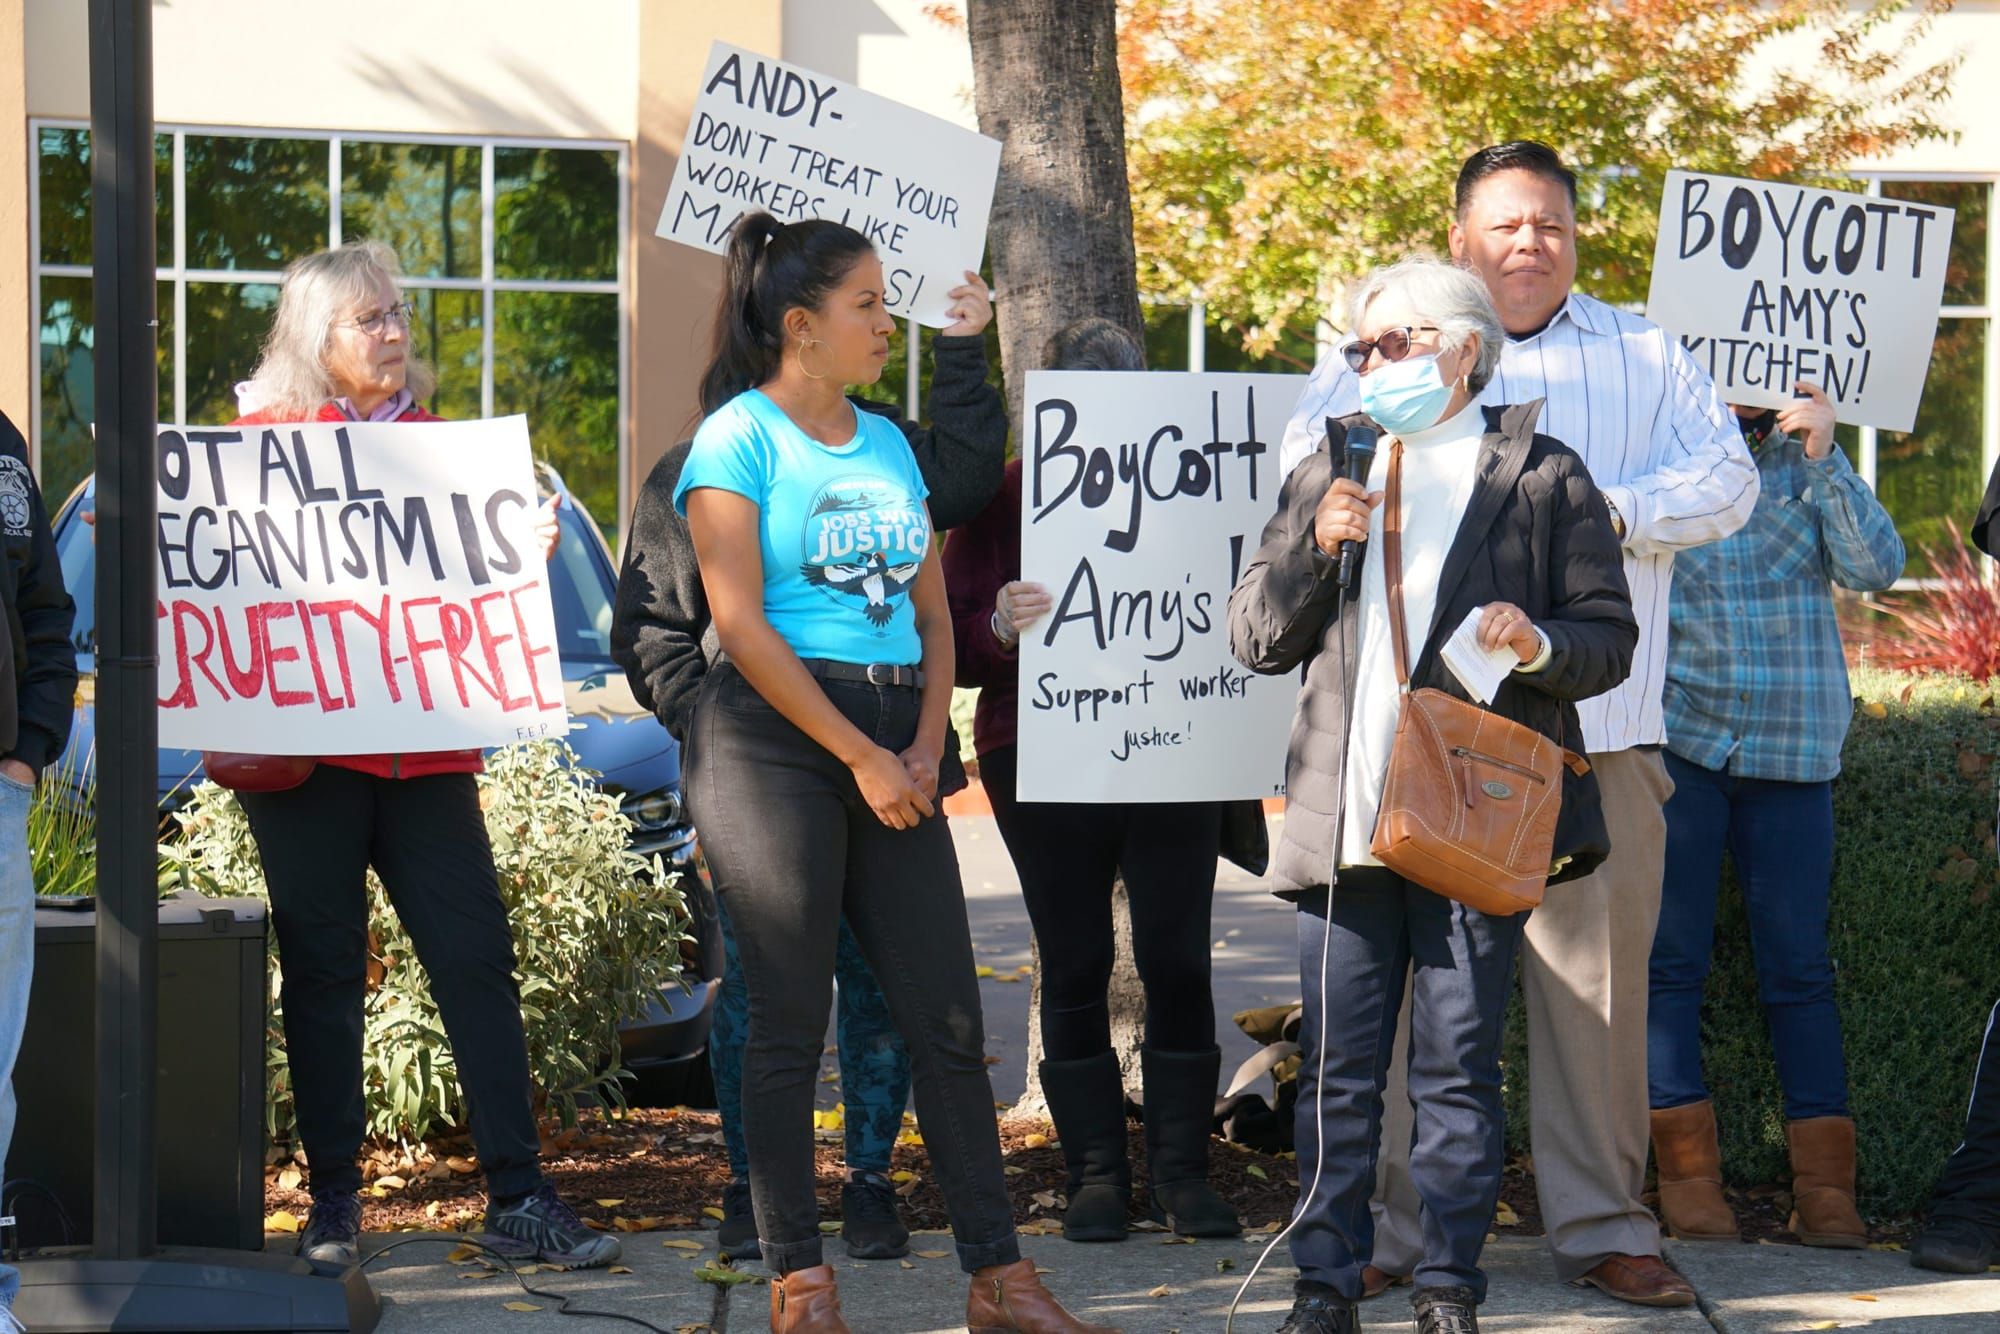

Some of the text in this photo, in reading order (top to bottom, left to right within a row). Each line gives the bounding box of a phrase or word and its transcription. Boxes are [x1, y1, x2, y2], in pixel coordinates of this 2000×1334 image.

[706, 53, 843, 127] ANDY-
[685, 155, 826, 220] WORKERS
[693, 112, 959, 228] DON'T TREAT YOUR
[1679, 178, 1936, 279] BOYCOTT
[1741, 279, 1868, 349] AMY'S
[157, 427, 385, 507] OT ALL
[157, 489, 528, 591] EGANISM IS
[820, 511, 872, 535] JOBS
[1032, 669, 1154, 723] Support
